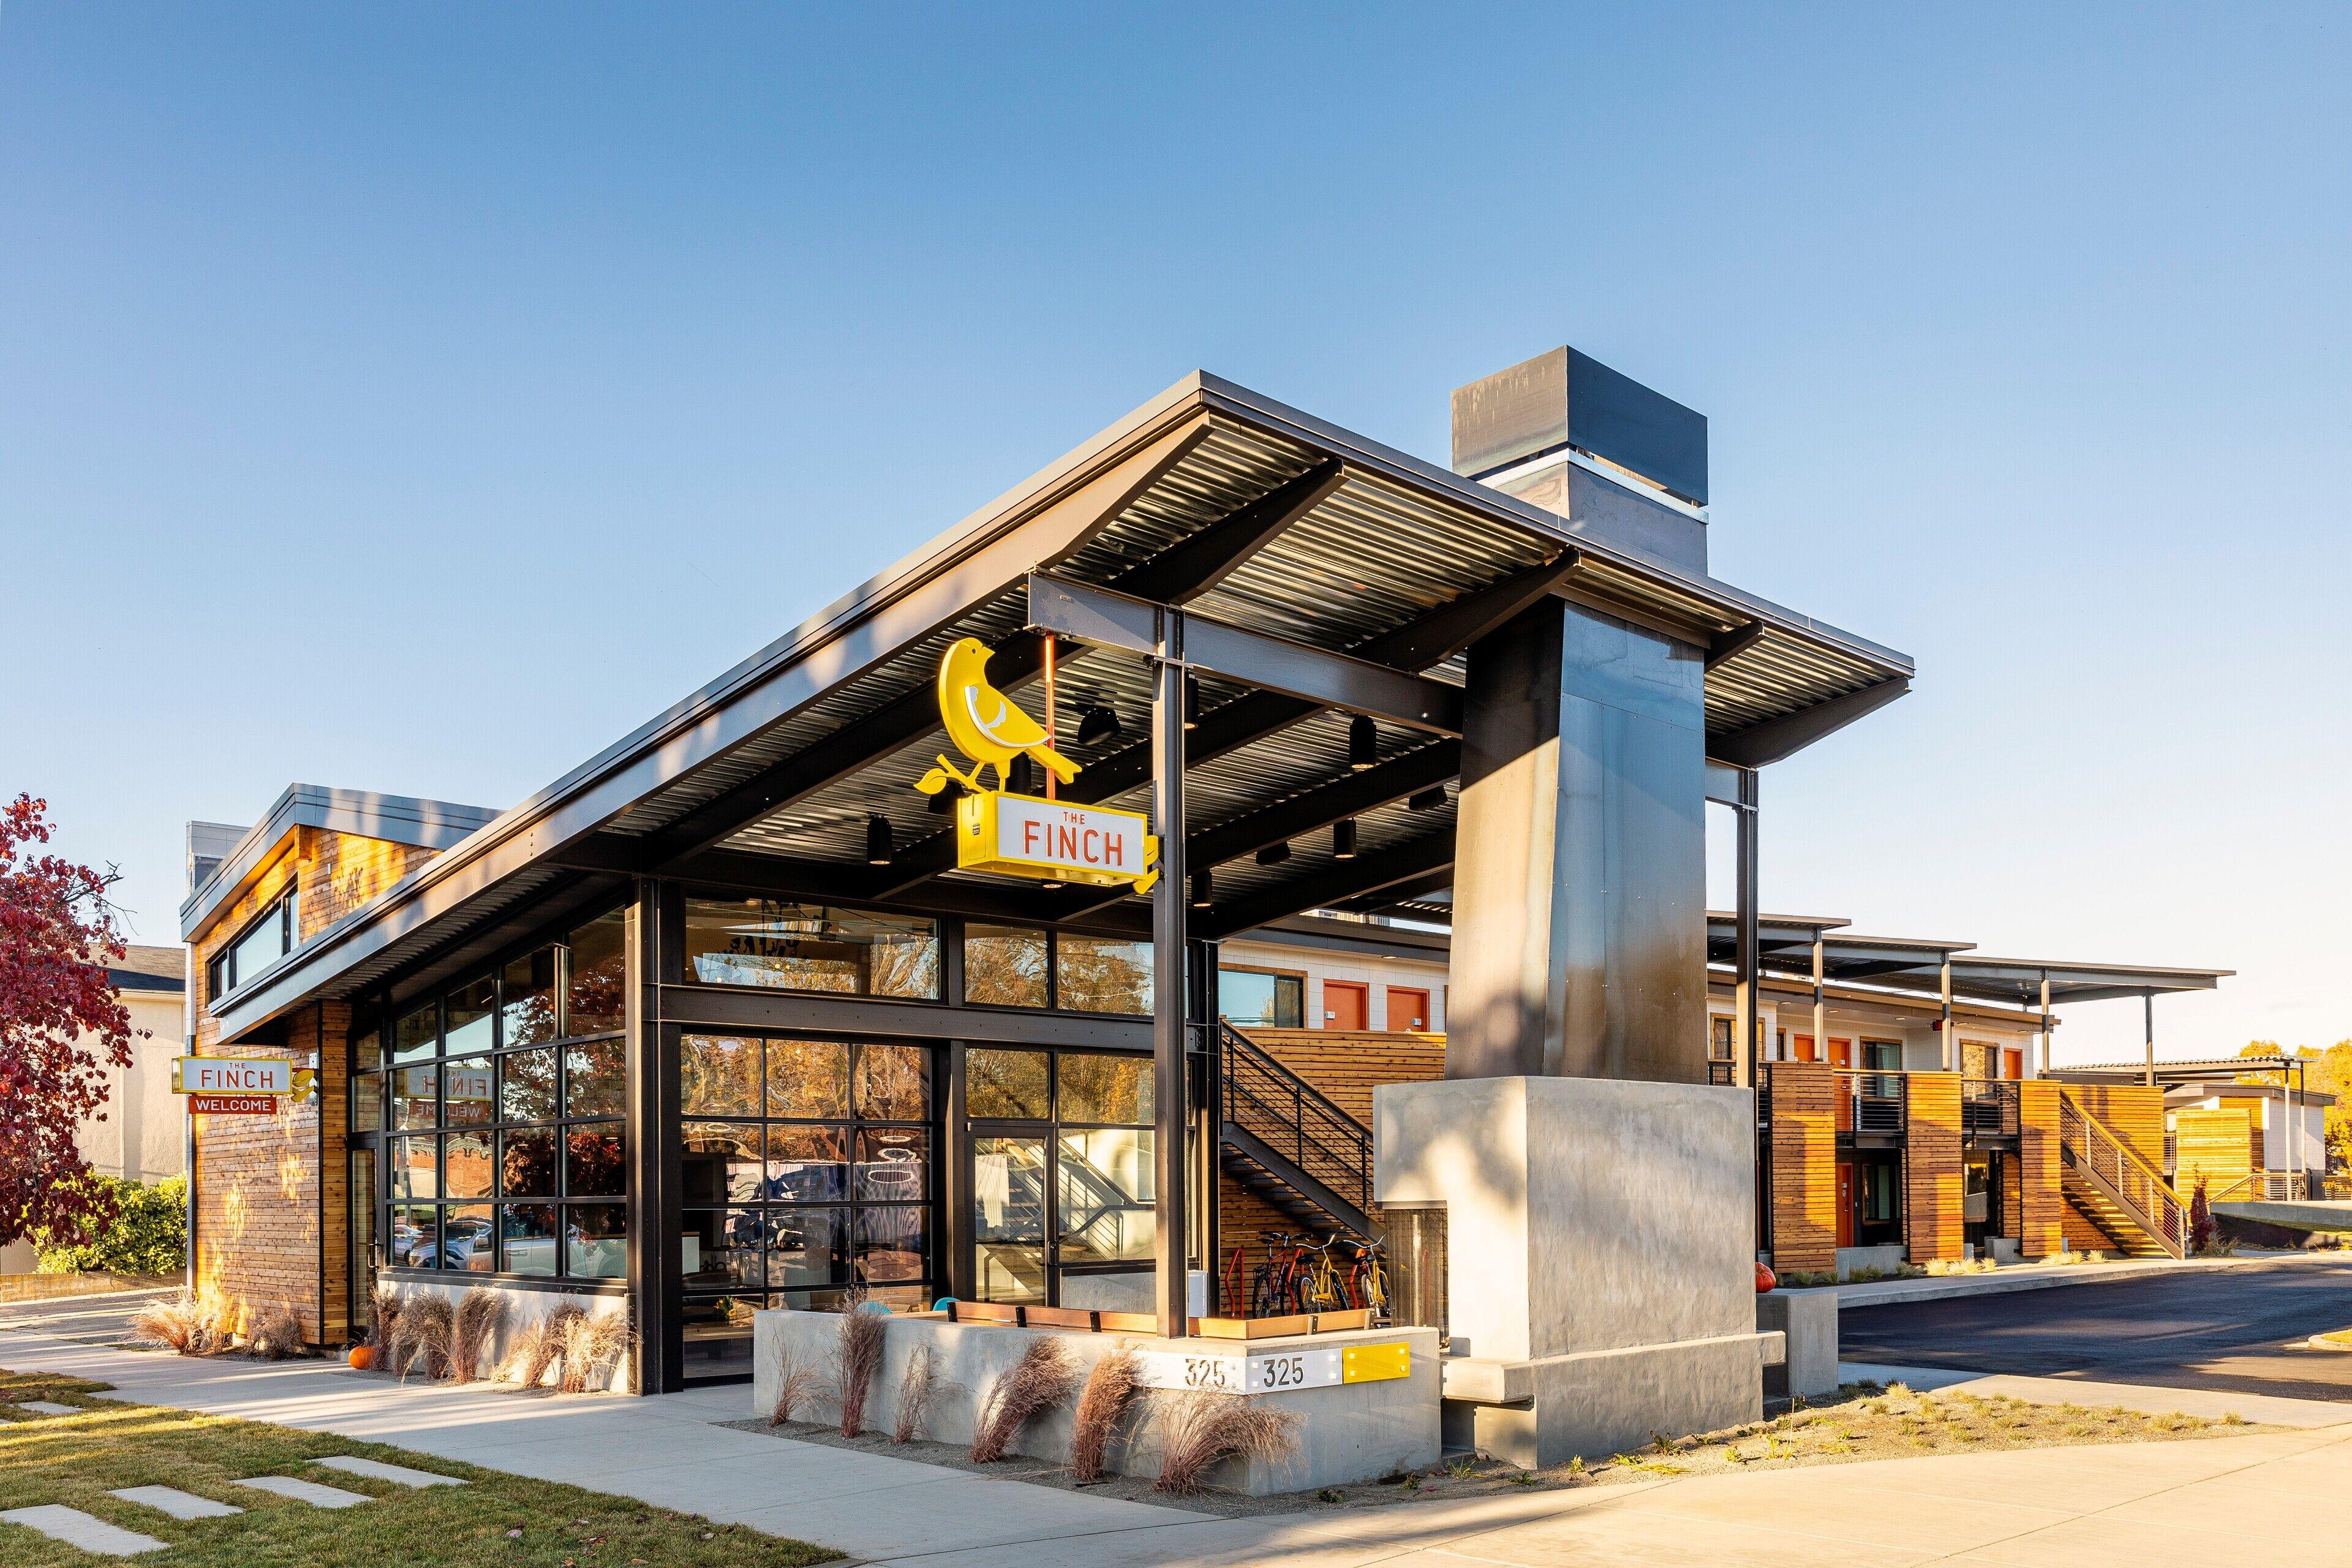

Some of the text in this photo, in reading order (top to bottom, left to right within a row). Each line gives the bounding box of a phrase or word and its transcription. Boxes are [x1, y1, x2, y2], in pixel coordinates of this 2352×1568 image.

[1063, 811, 1085, 825] THE
[1023, 820, 1123, 866] FINCH
[201, 1069, 273, 1088] FINCH
[195, 1099, 271, 1111] WELCOME
[1185, 1359, 1225, 1387] 325
[1264, 1357, 1304, 1388] 325
